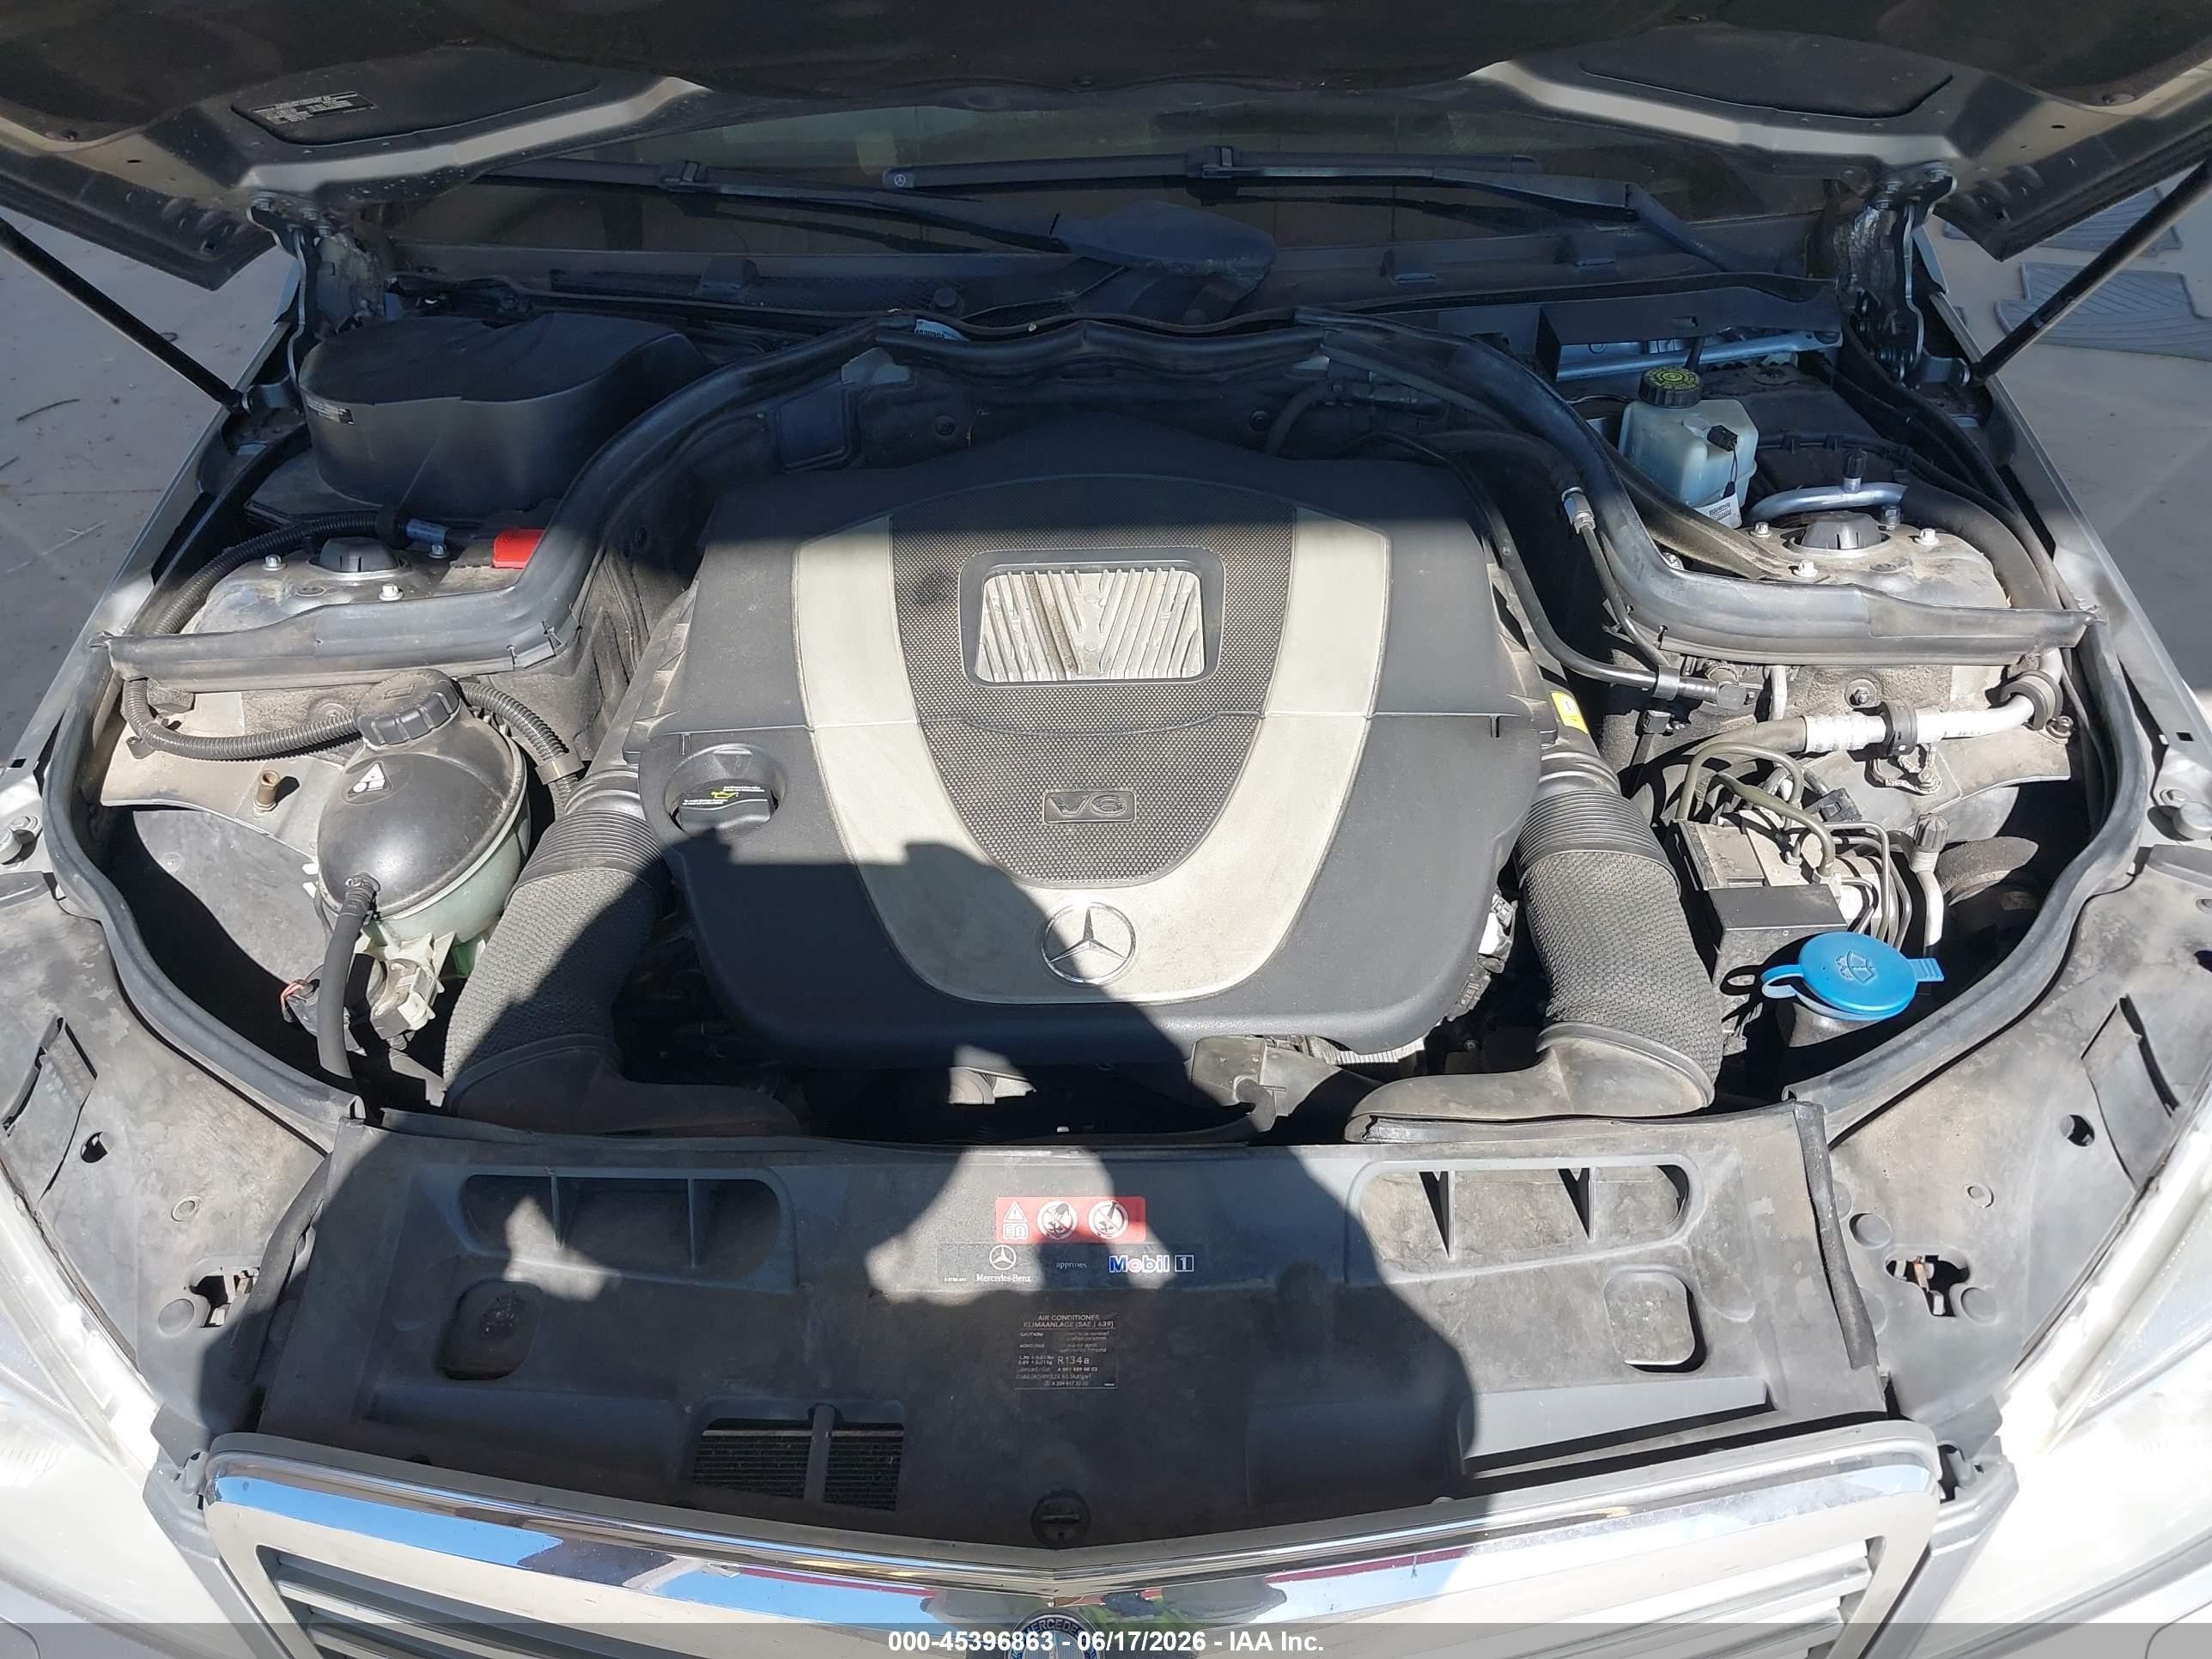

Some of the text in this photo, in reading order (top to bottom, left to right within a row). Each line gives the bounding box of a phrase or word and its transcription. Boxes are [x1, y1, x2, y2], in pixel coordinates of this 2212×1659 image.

[1049, 794, 1127, 815] V6
[1056, 1261, 1087, 1270] approves
[1109, 1254, 1170, 1273] Mobil
[975, 1273, 1031, 1283] Mercedes-Benz
